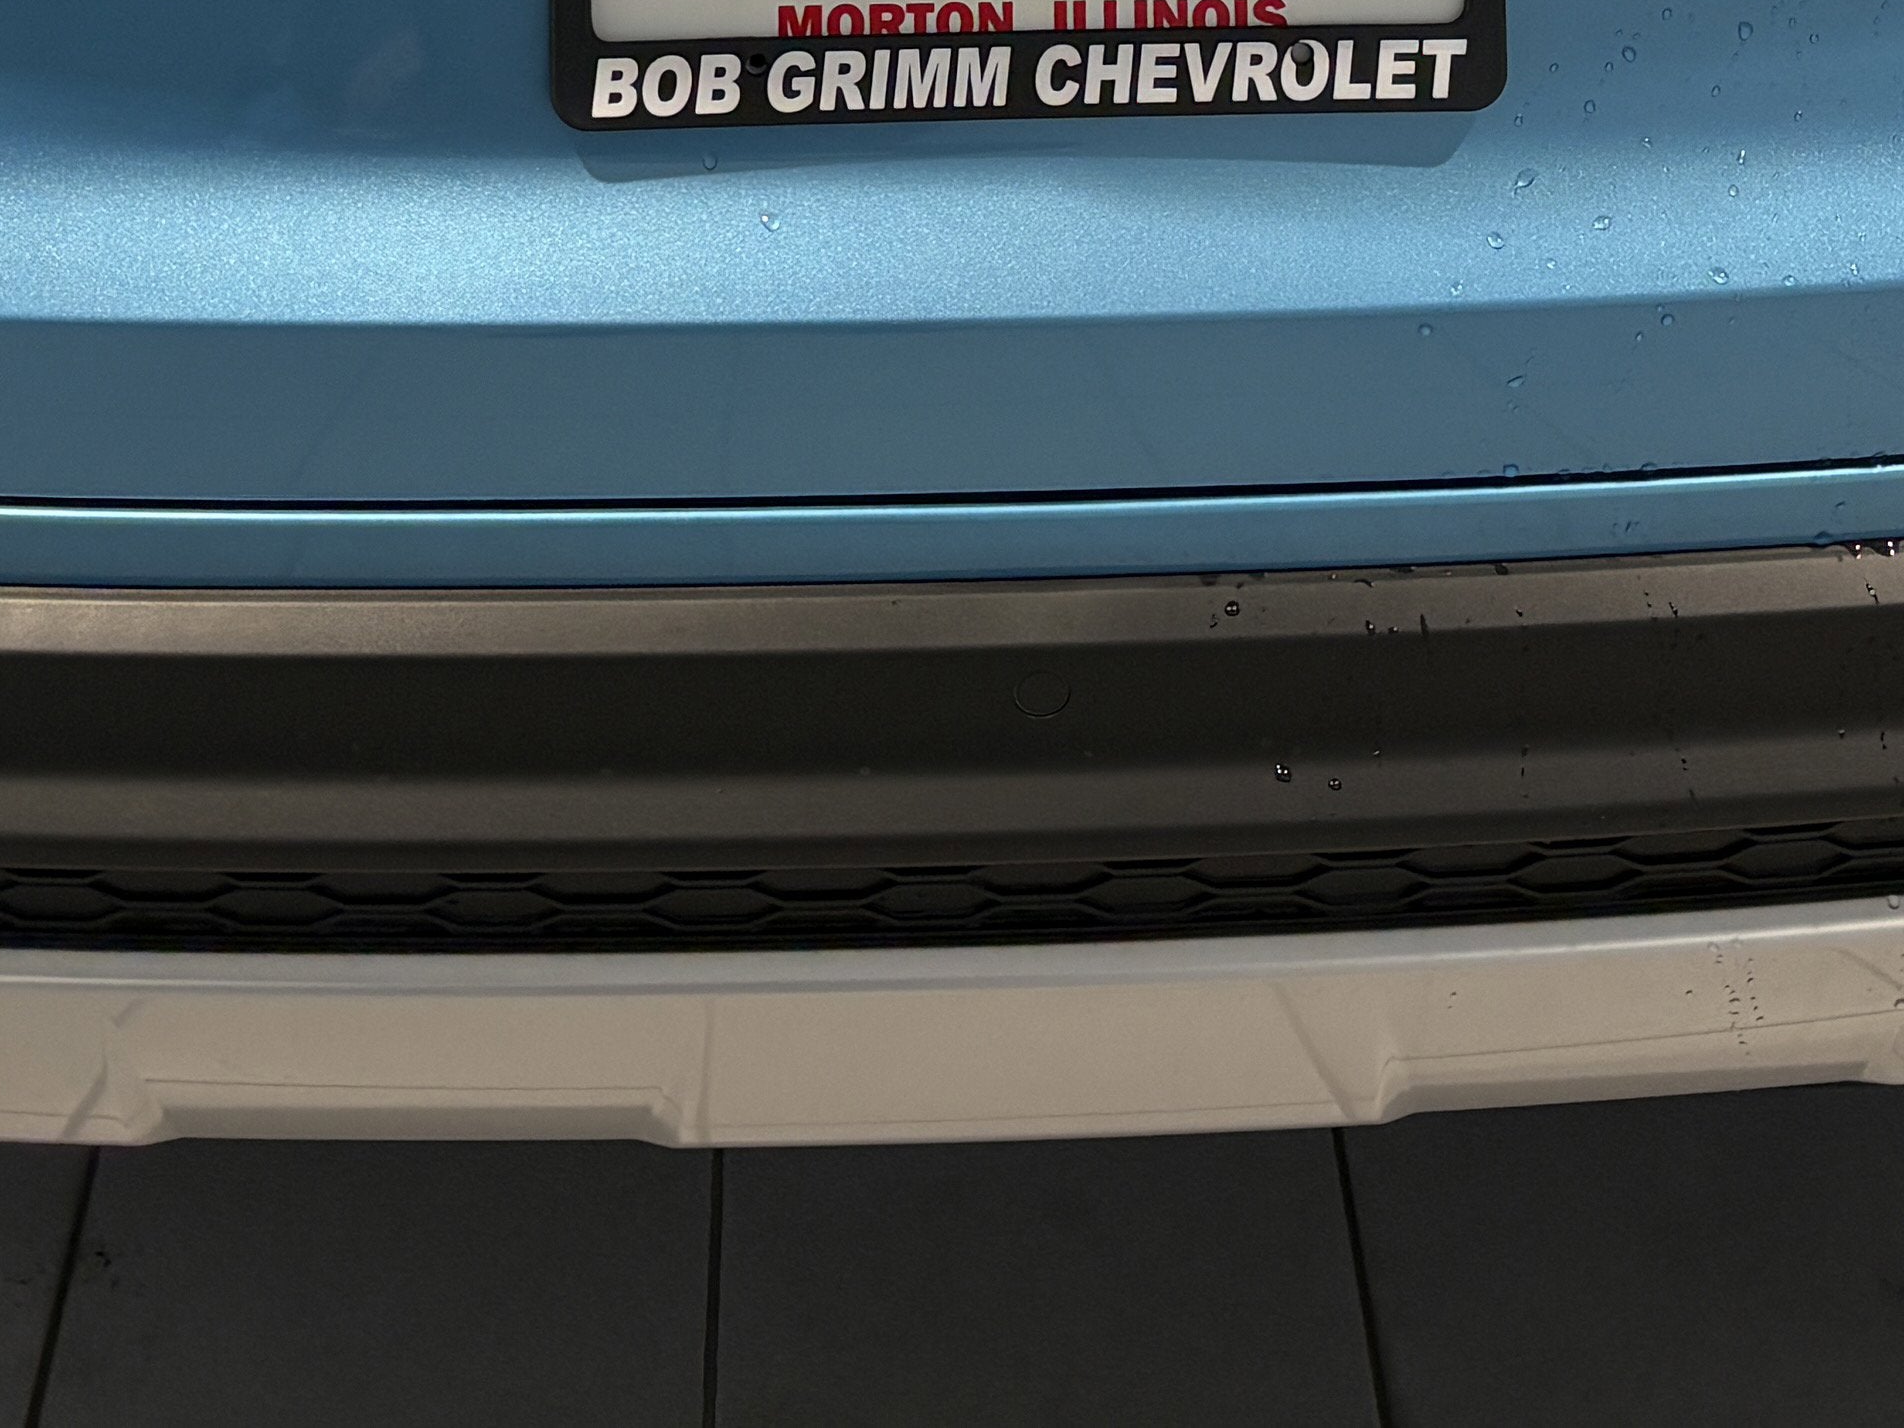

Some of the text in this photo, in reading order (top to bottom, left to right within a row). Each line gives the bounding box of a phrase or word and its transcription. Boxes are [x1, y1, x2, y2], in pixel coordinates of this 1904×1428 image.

[777, 1, 1014, 37] MORTON
[591, 38, 1469, 119] BOB GRIMM CHEVROLET
